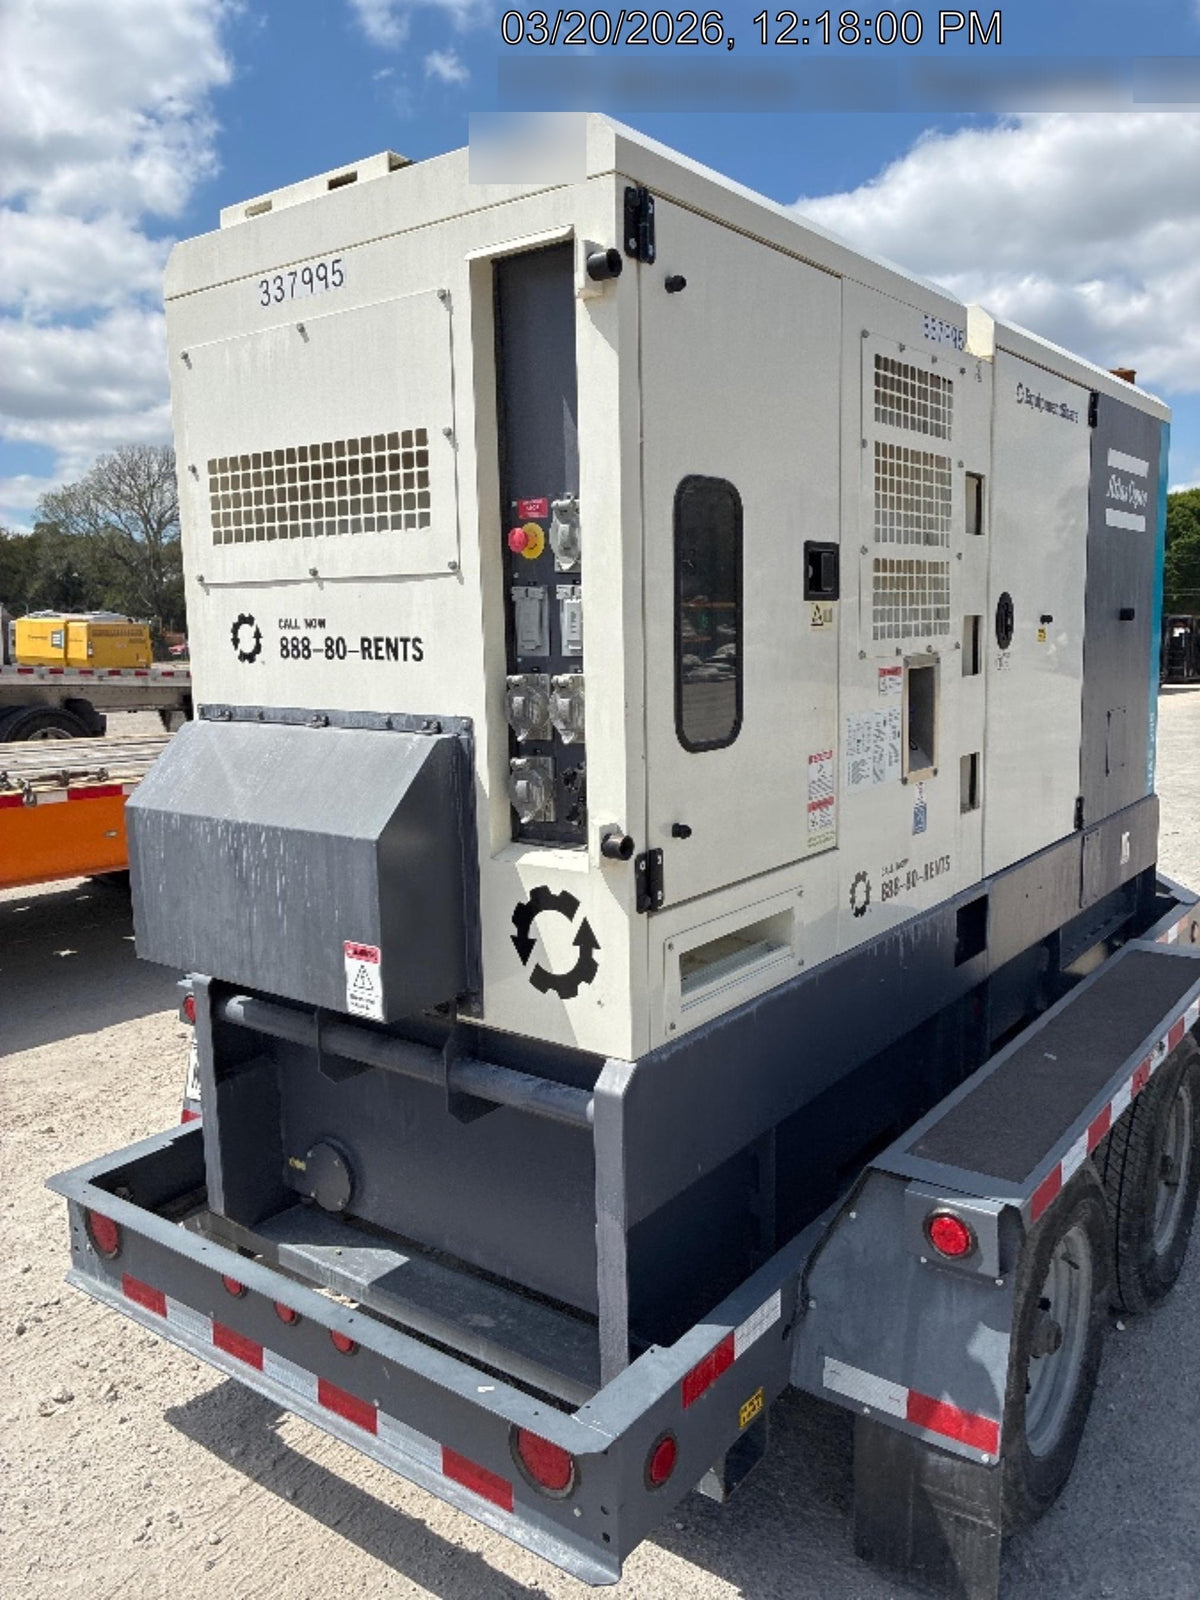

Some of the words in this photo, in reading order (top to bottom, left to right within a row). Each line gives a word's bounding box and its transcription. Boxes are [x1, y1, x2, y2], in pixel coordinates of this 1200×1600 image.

[259, 258, 344, 306] 337995
[278, 618, 301, 630] CALL
[303, 618, 326, 629] NOW
[279, 636, 424, 662] 888-80-RENTS
